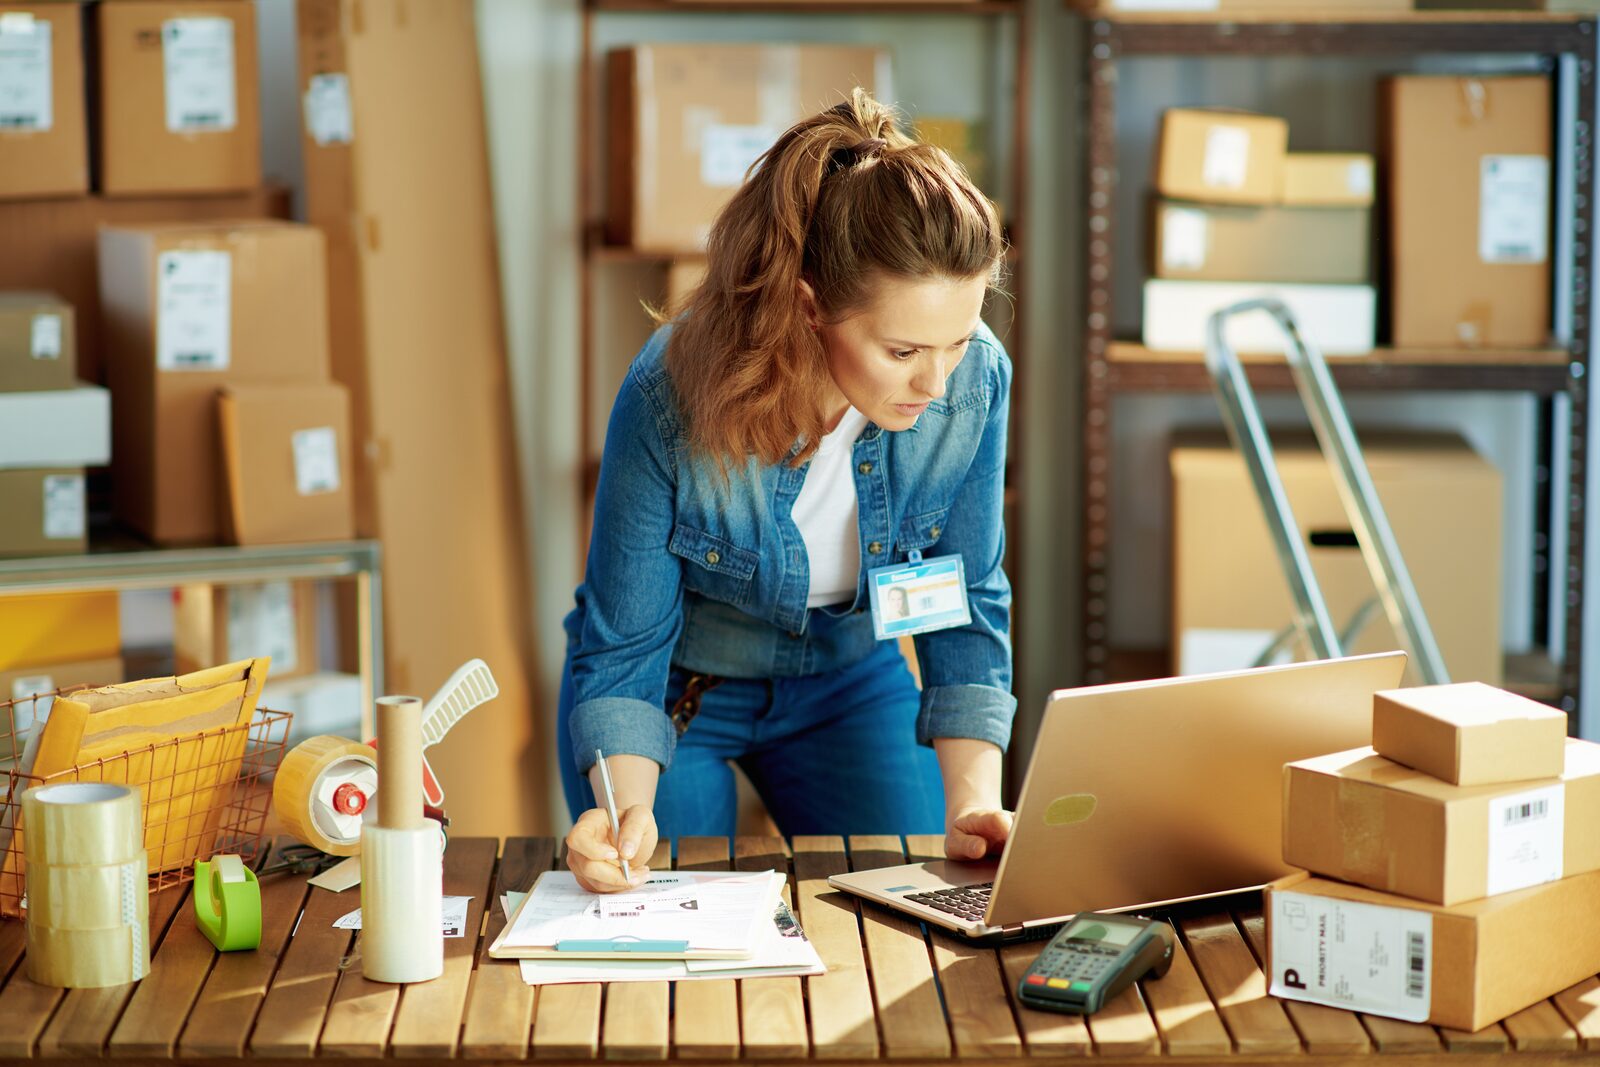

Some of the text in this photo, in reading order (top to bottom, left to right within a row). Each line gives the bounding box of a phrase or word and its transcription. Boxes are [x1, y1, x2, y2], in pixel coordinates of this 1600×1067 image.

[1318, 913, 1327, 987] PRIORITY MAIL
[1284, 968, 1307, 990] P
